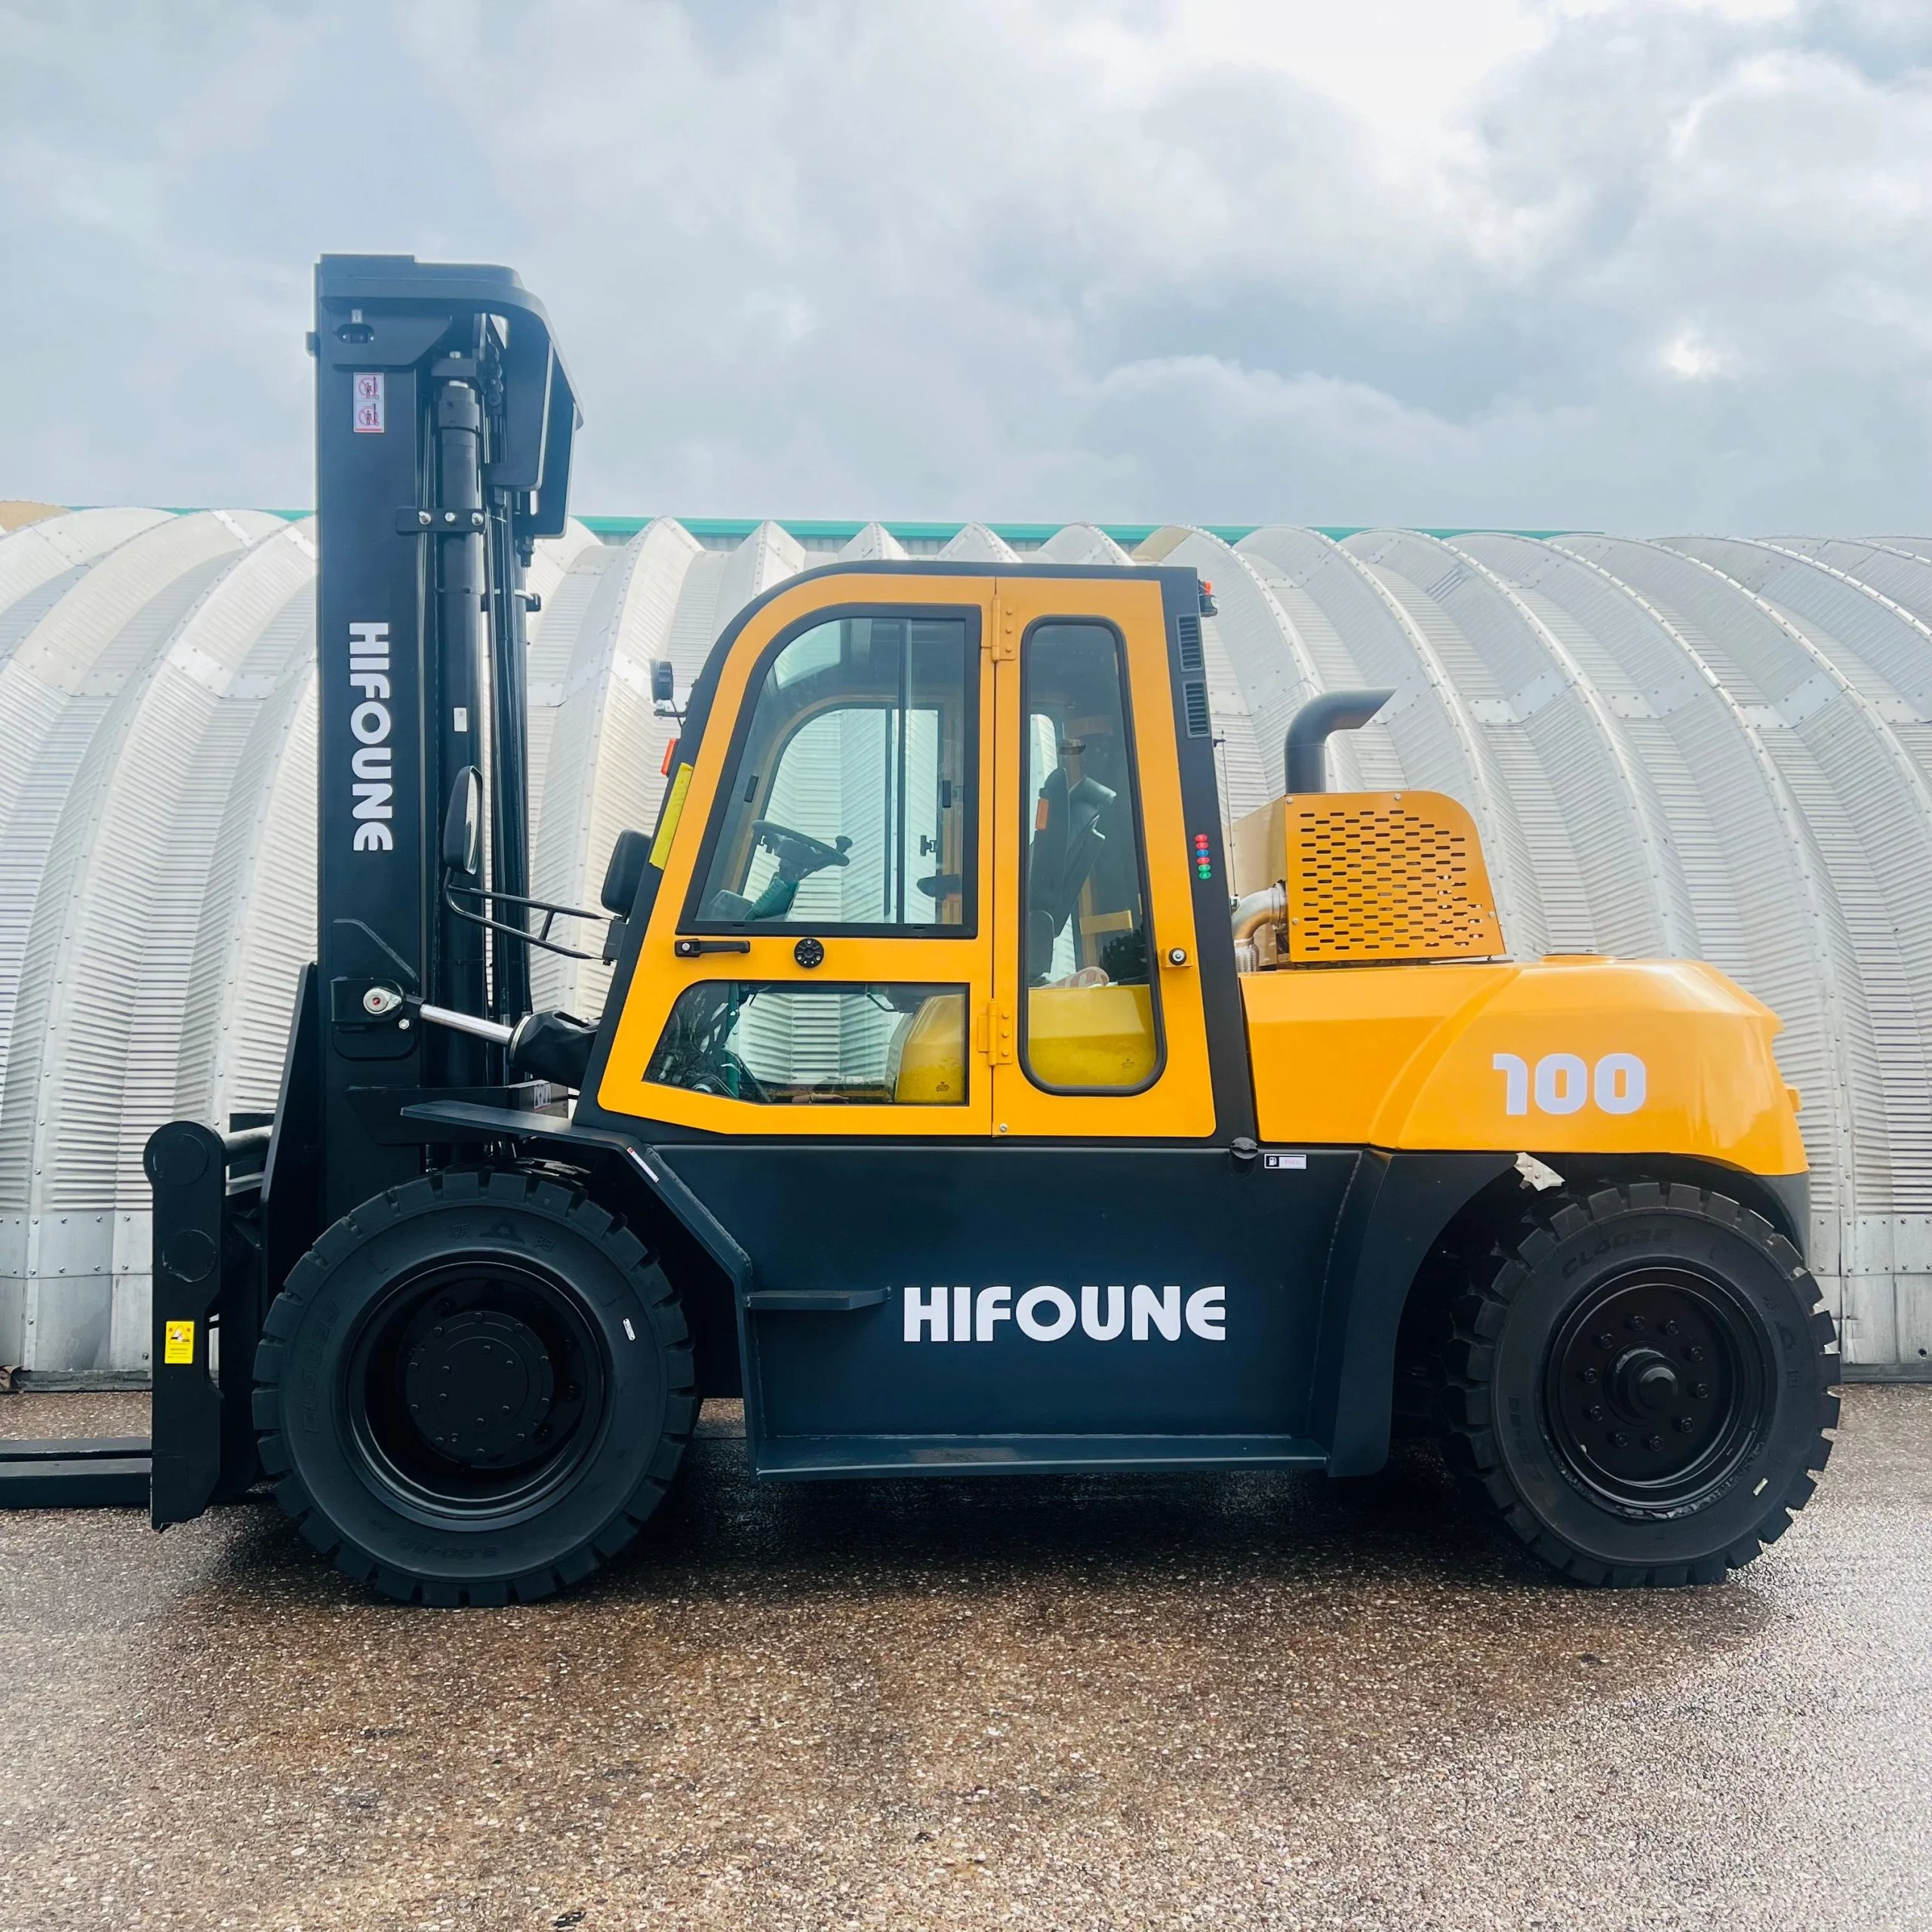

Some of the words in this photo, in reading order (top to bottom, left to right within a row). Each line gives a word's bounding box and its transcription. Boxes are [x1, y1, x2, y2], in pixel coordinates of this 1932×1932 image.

[349, 622, 393, 851] HIFOUNE
[1493, 1053, 1647, 1115] 100
[903, 1284, 1226, 1342] HIFOUNE
